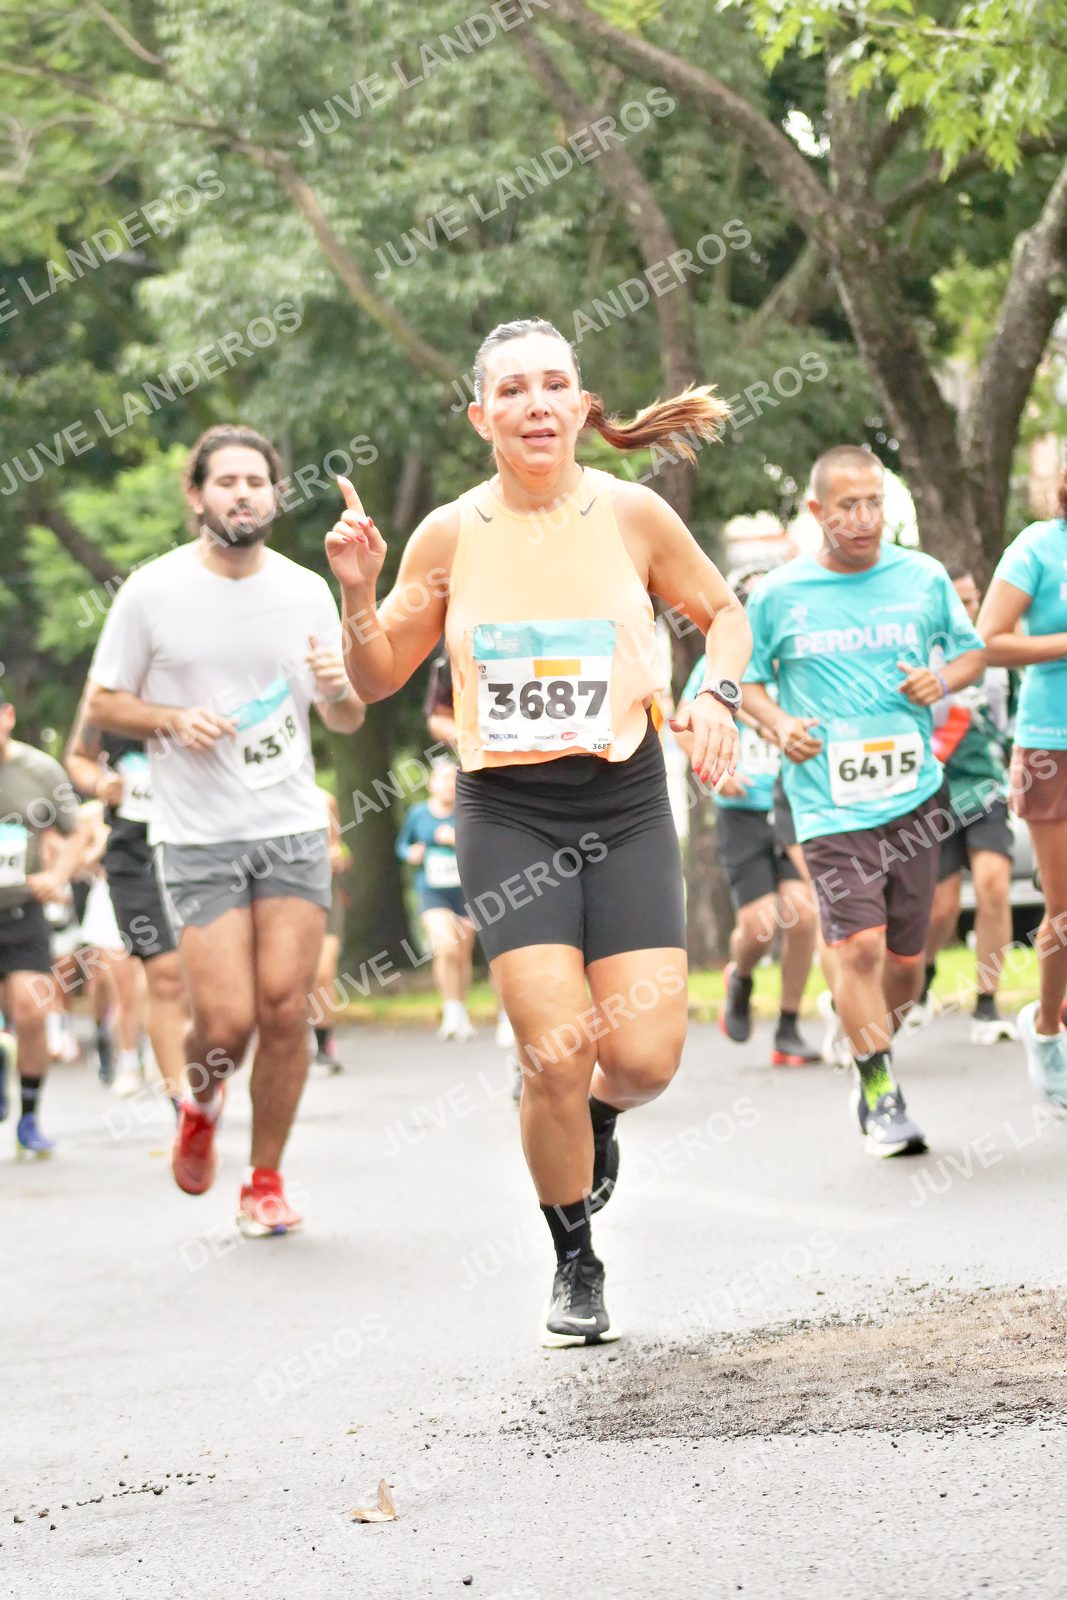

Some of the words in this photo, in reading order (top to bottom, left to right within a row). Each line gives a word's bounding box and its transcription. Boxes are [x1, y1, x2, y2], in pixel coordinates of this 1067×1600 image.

[794, 623, 918, 656] PERDURA
[488, 681, 607, 720] 3687
[243, 715, 296, 766] 4318
[839, 750, 916, 782] 6415
